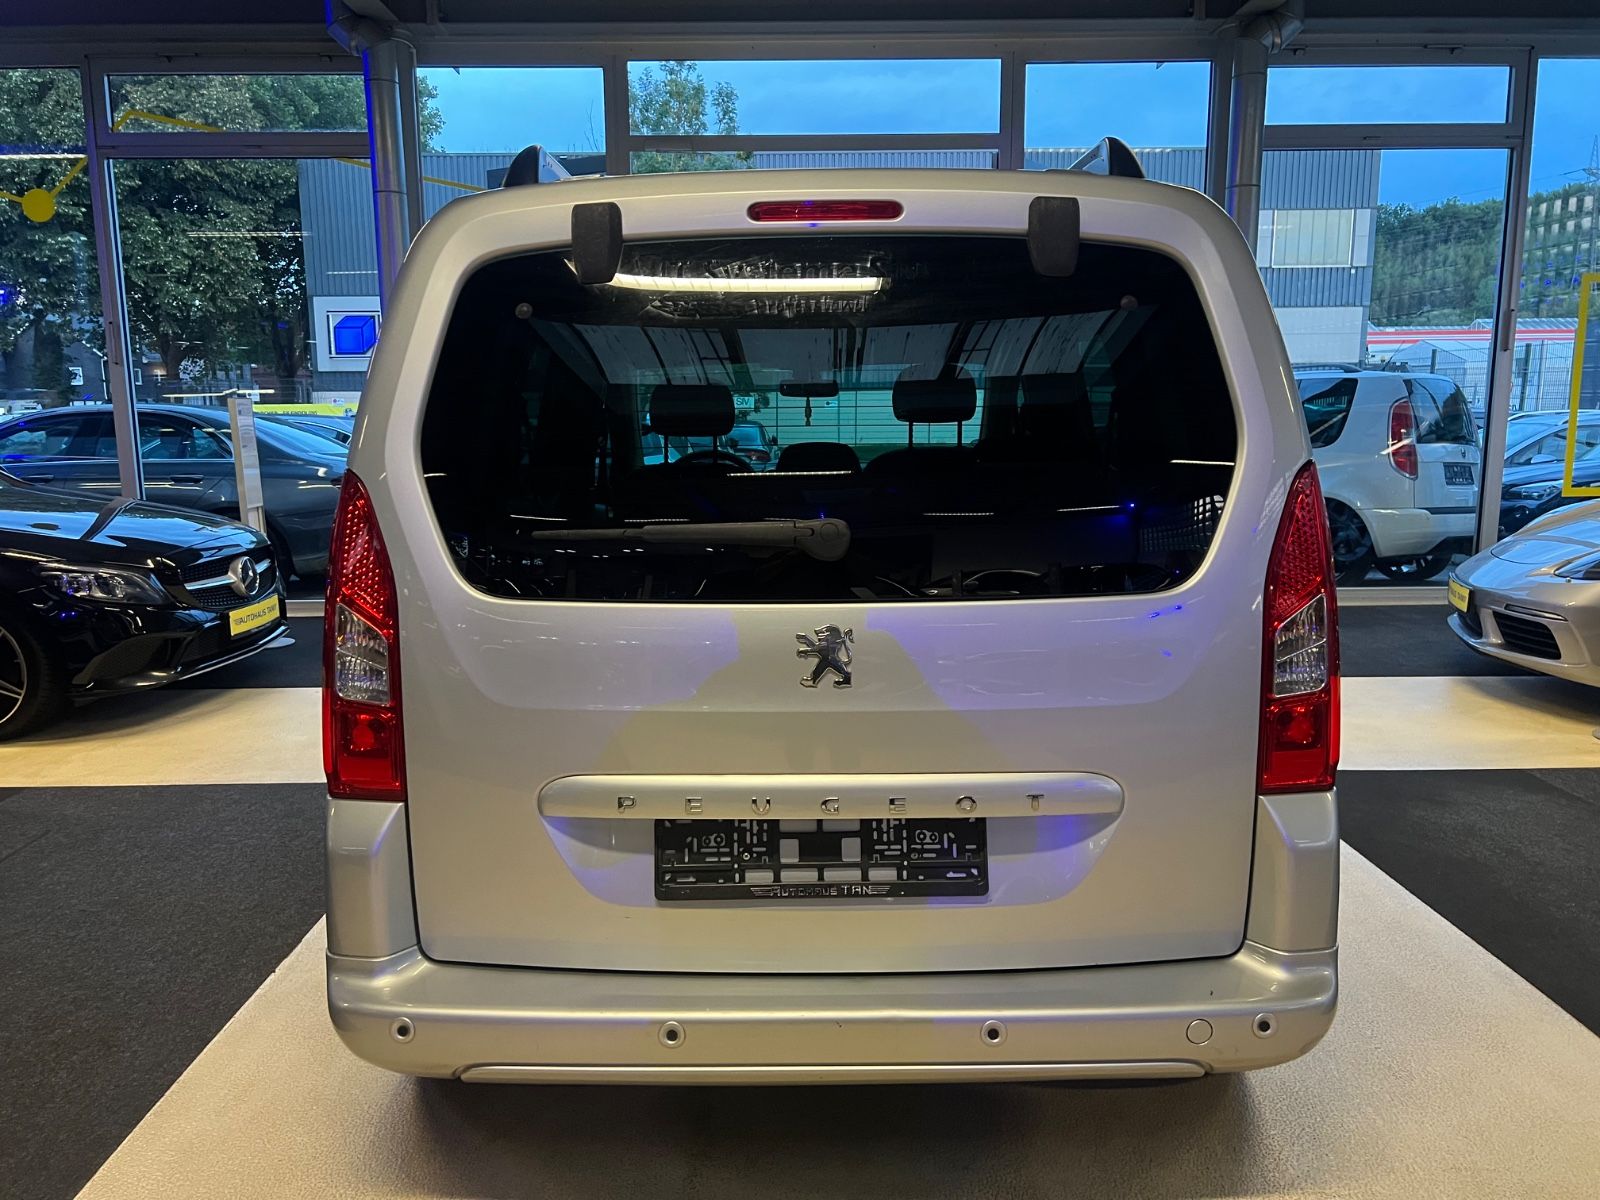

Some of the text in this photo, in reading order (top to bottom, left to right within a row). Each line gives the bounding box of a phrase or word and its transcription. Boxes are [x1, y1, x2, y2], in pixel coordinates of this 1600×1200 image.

[240, 608, 267, 624] AUTOHAUS
[617, 793, 1045, 815] PEUGEOT
[770, 885, 872, 897] AUTOHAUS TAN
